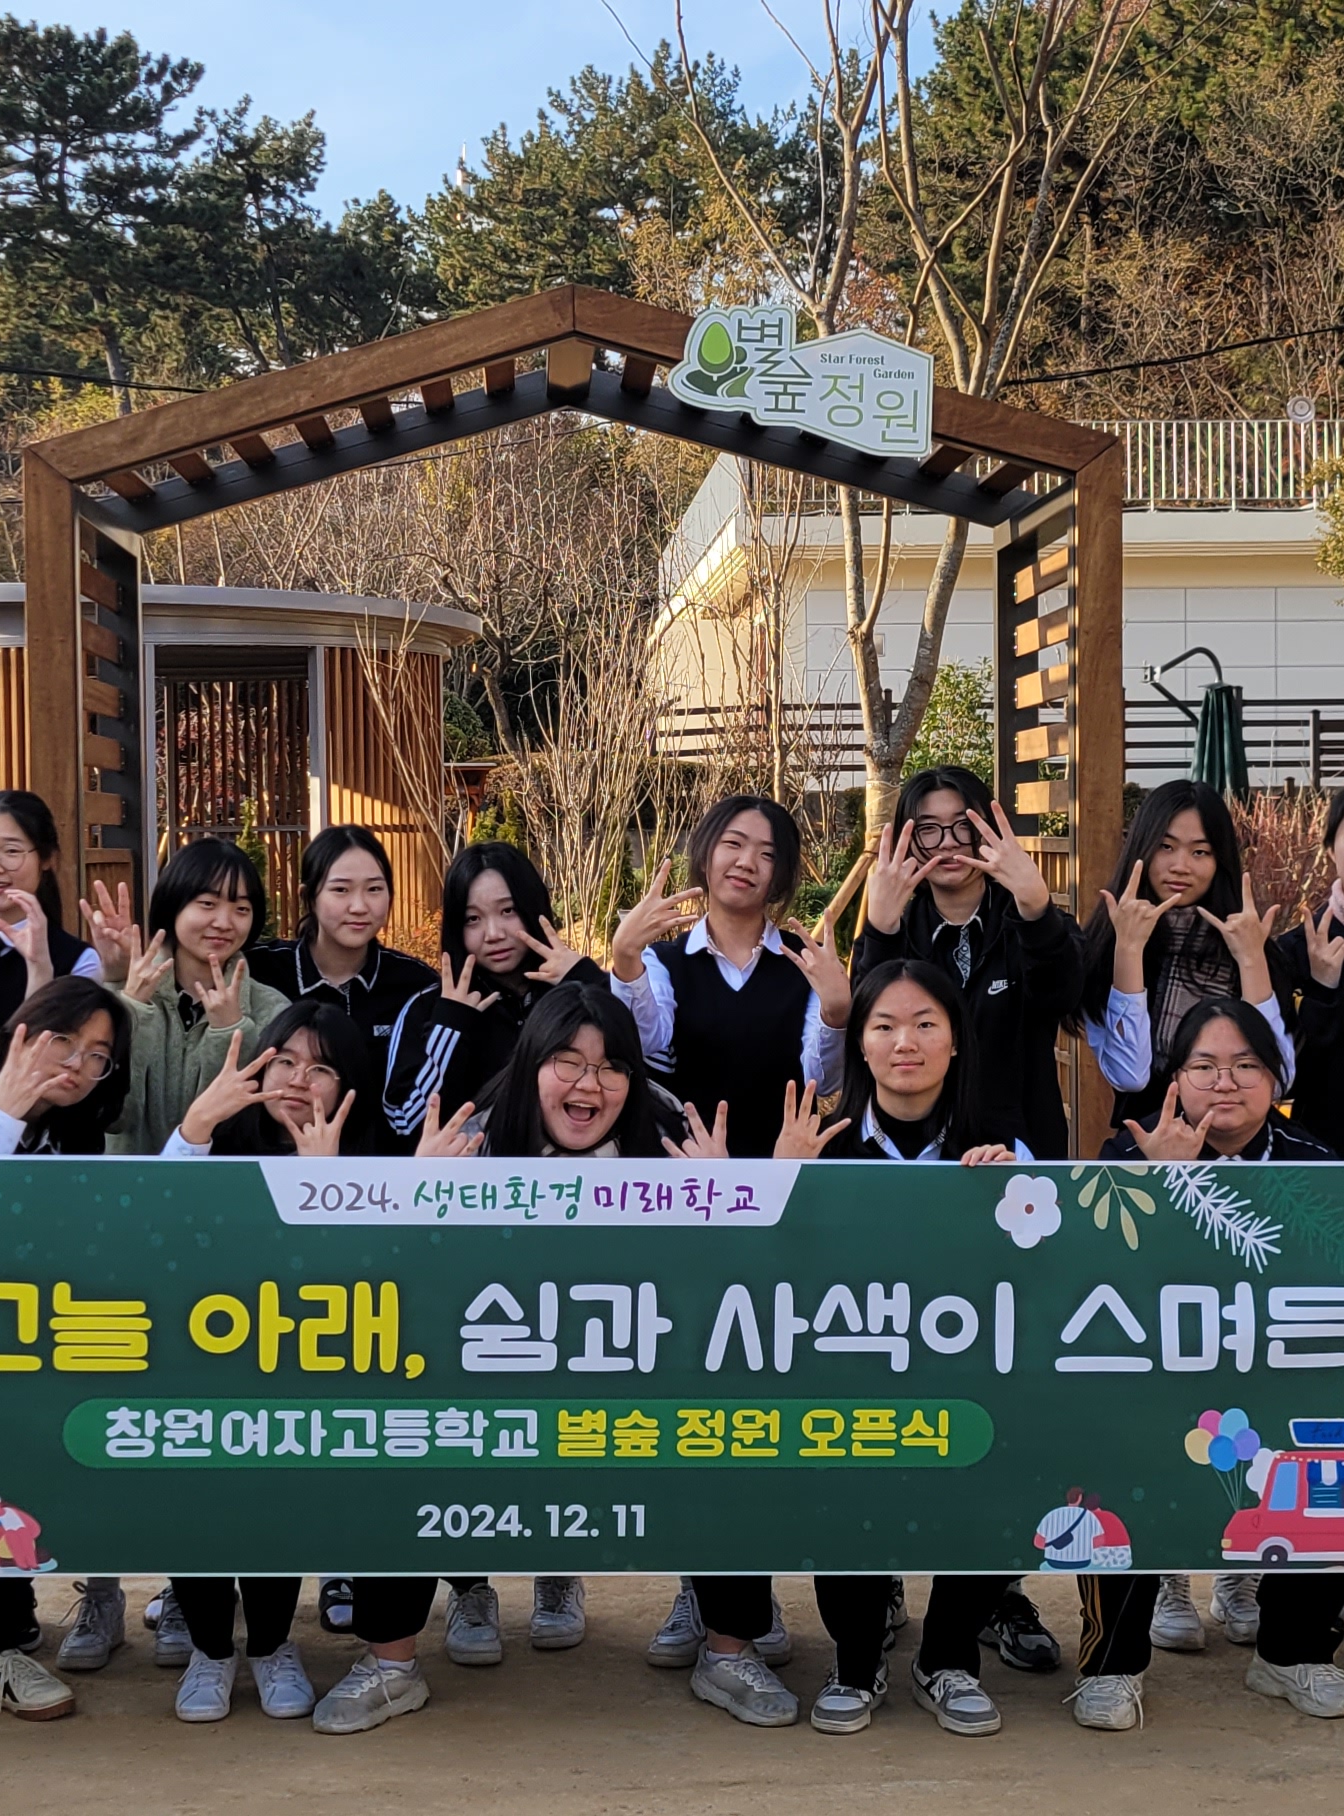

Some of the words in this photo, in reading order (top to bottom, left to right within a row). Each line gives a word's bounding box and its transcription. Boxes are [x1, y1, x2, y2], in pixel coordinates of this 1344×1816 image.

[819, 352, 845, 364] Star
[848, 353, 886, 365] Forest
[872, 367, 915, 380] Garden
[818, 372, 920, 444] 정원
[297, 1180, 401, 1213] 2024.
[188, 1280, 427, 1380] 아래,
[459, 1281, 674, 1374] 쉼과
[704, 1281, 1015, 1375] 사색이
[104, 1406, 541, 1458] 창원여자고등학교
[557, 1408, 661, 1458] 별숲
[675, 1408, 782, 1458] 정원
[798, 1408, 950, 1458] 오픈식
[416, 1503, 534, 1539] 2024.
[545, 1503, 601, 1538] 12.
[611, 1504, 647, 1538] 11
